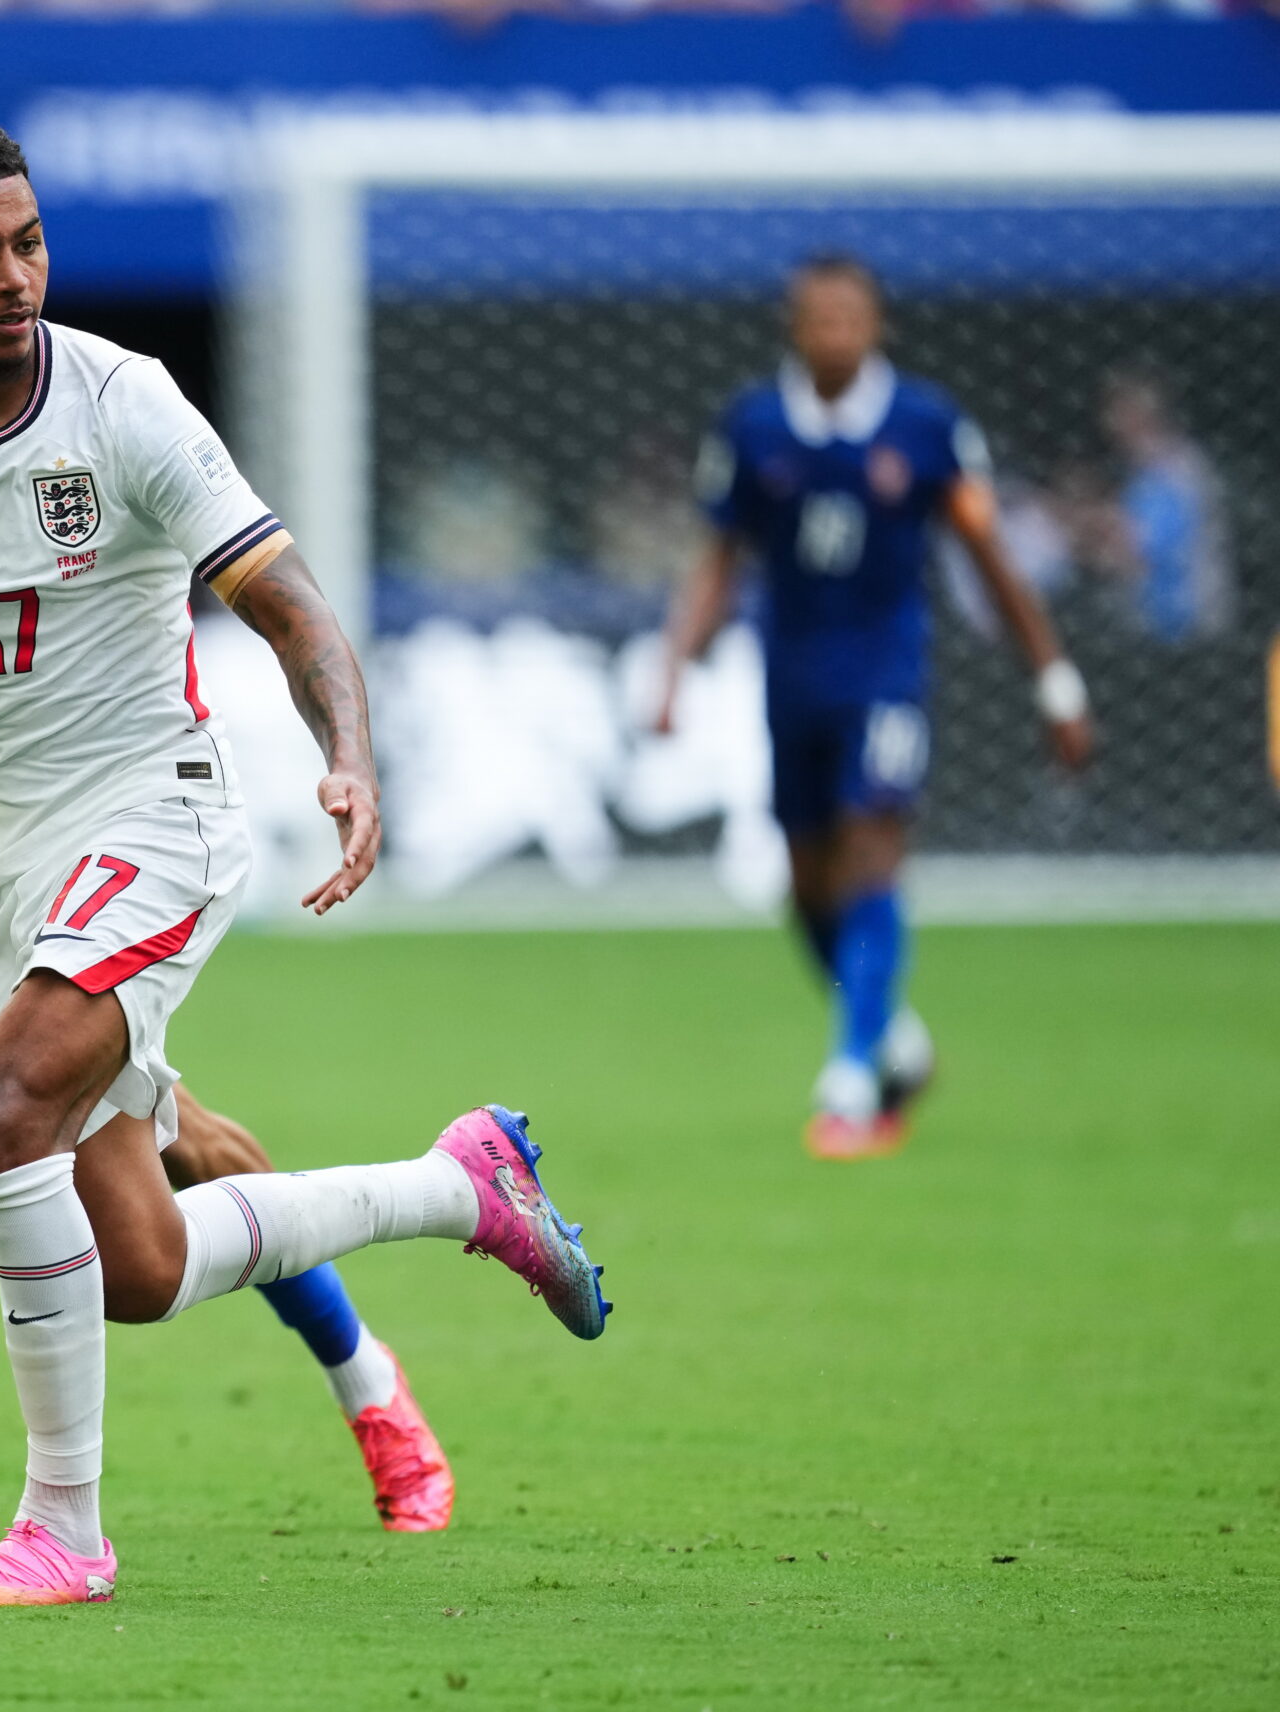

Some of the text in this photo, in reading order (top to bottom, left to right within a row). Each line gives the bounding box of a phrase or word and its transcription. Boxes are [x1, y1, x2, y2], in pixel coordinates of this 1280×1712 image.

[56, 549, 98, 569] FRANCE
[45, 853, 141, 932] 17
[488, 1178, 512, 1207] FUTURE
